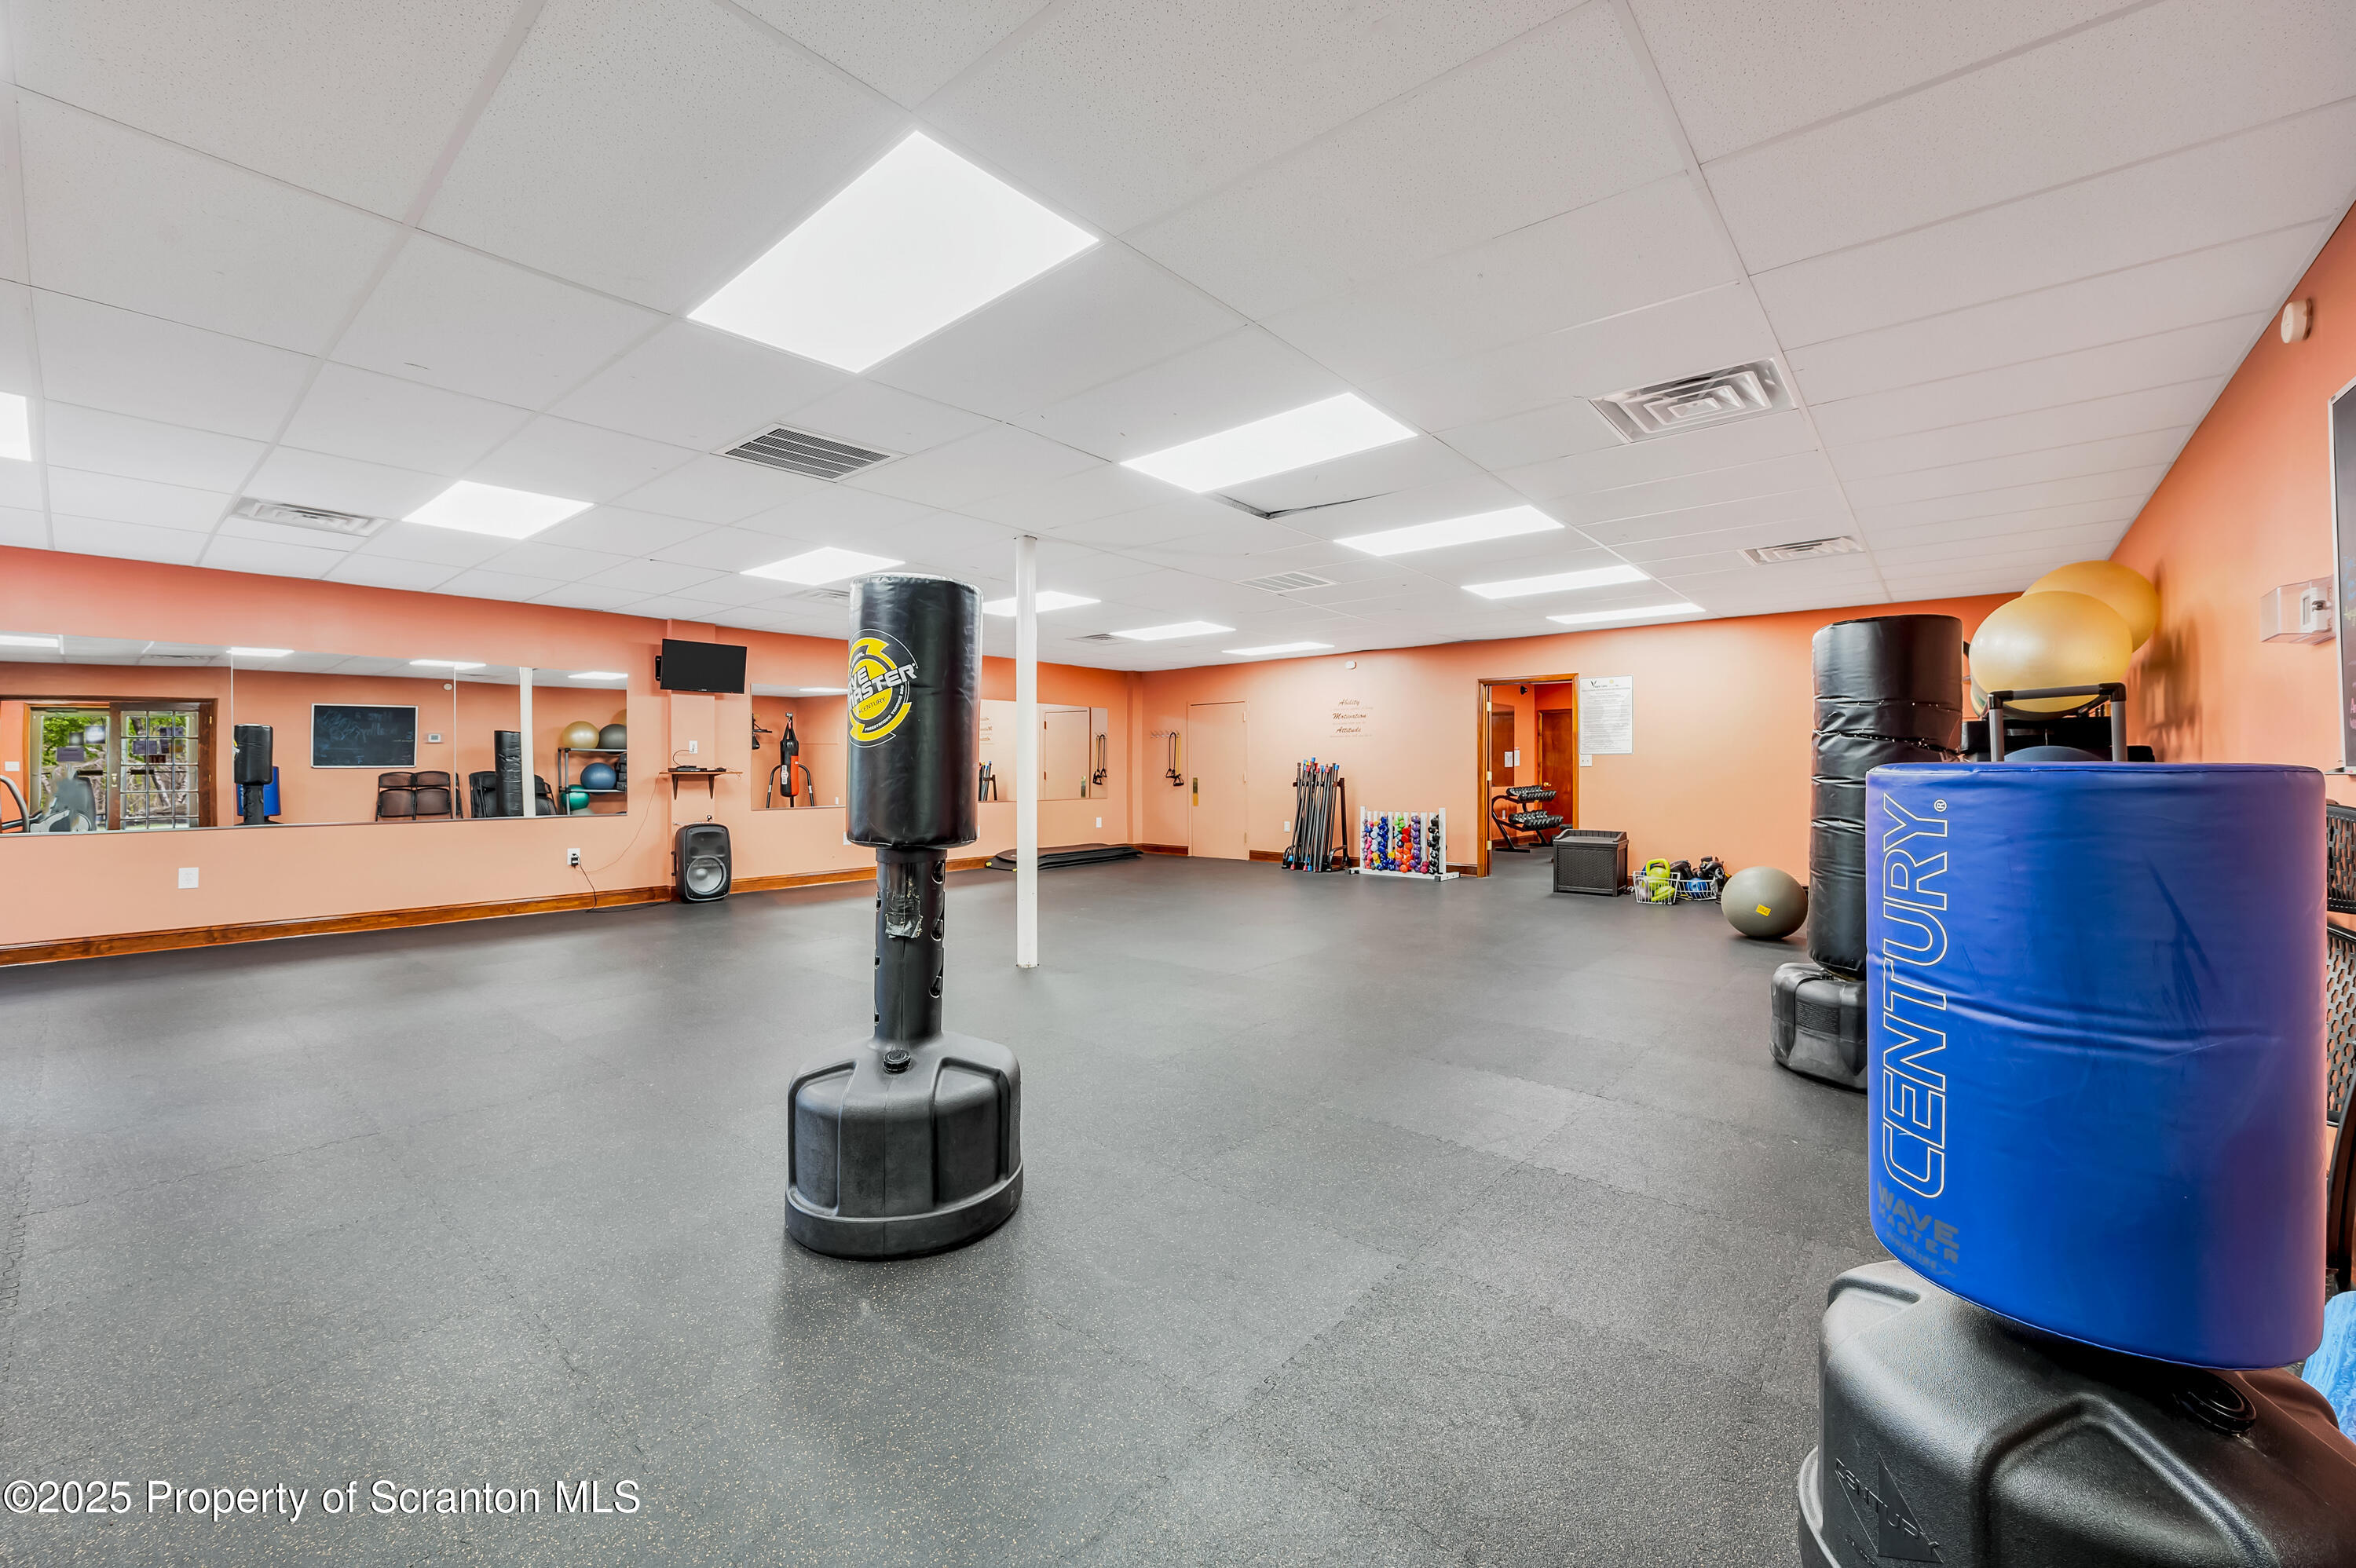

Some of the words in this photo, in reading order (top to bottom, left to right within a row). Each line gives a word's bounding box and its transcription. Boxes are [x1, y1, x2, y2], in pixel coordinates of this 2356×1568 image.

[848, 666, 869, 696] AVE
[861, 696, 886, 713] CENTURY
[1883, 792, 1948, 1199] CENTURY
[1877, 1180, 1960, 1250] WAVE
